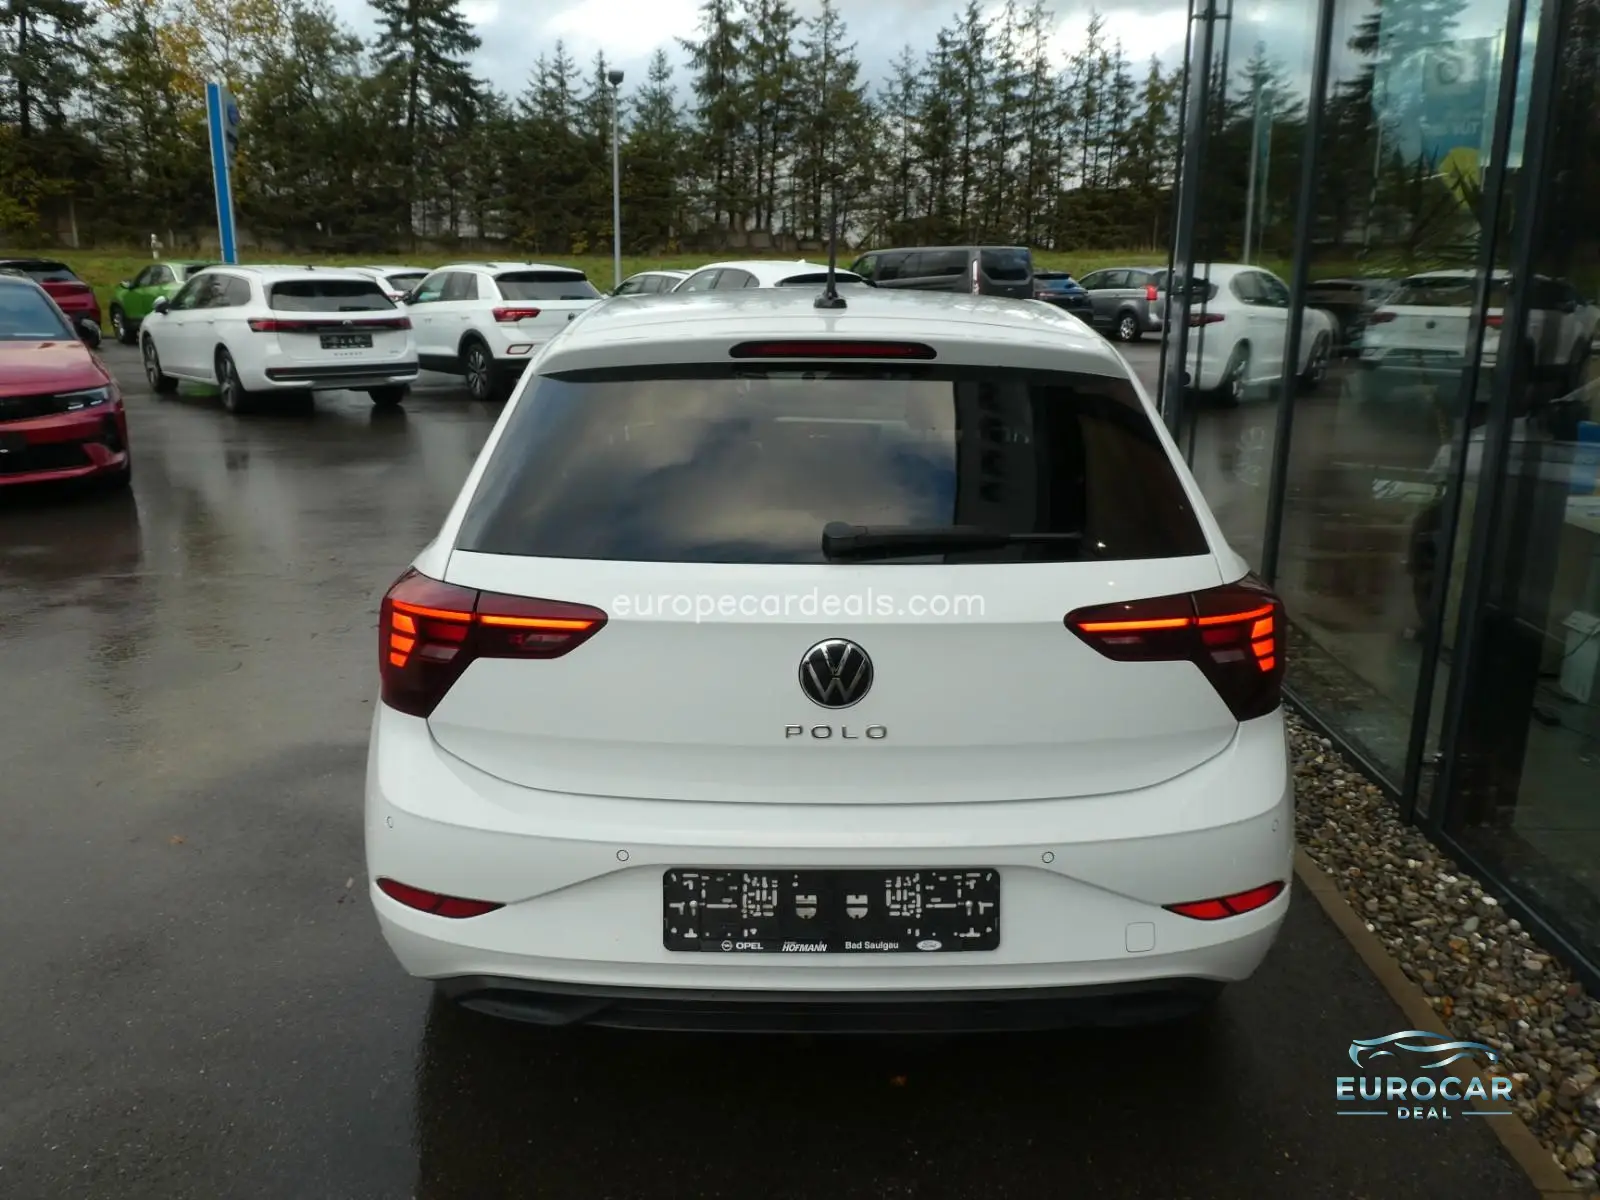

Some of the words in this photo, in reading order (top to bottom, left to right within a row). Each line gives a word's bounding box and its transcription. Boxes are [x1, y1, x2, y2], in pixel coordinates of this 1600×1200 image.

[784, 723, 889, 740] POLO
[735, 941, 765, 950] OPEL
[782, 942, 828, 952] HOFMANN
[844, 941, 863, 950] Bad
[864, 941, 899, 951] Saulgau
